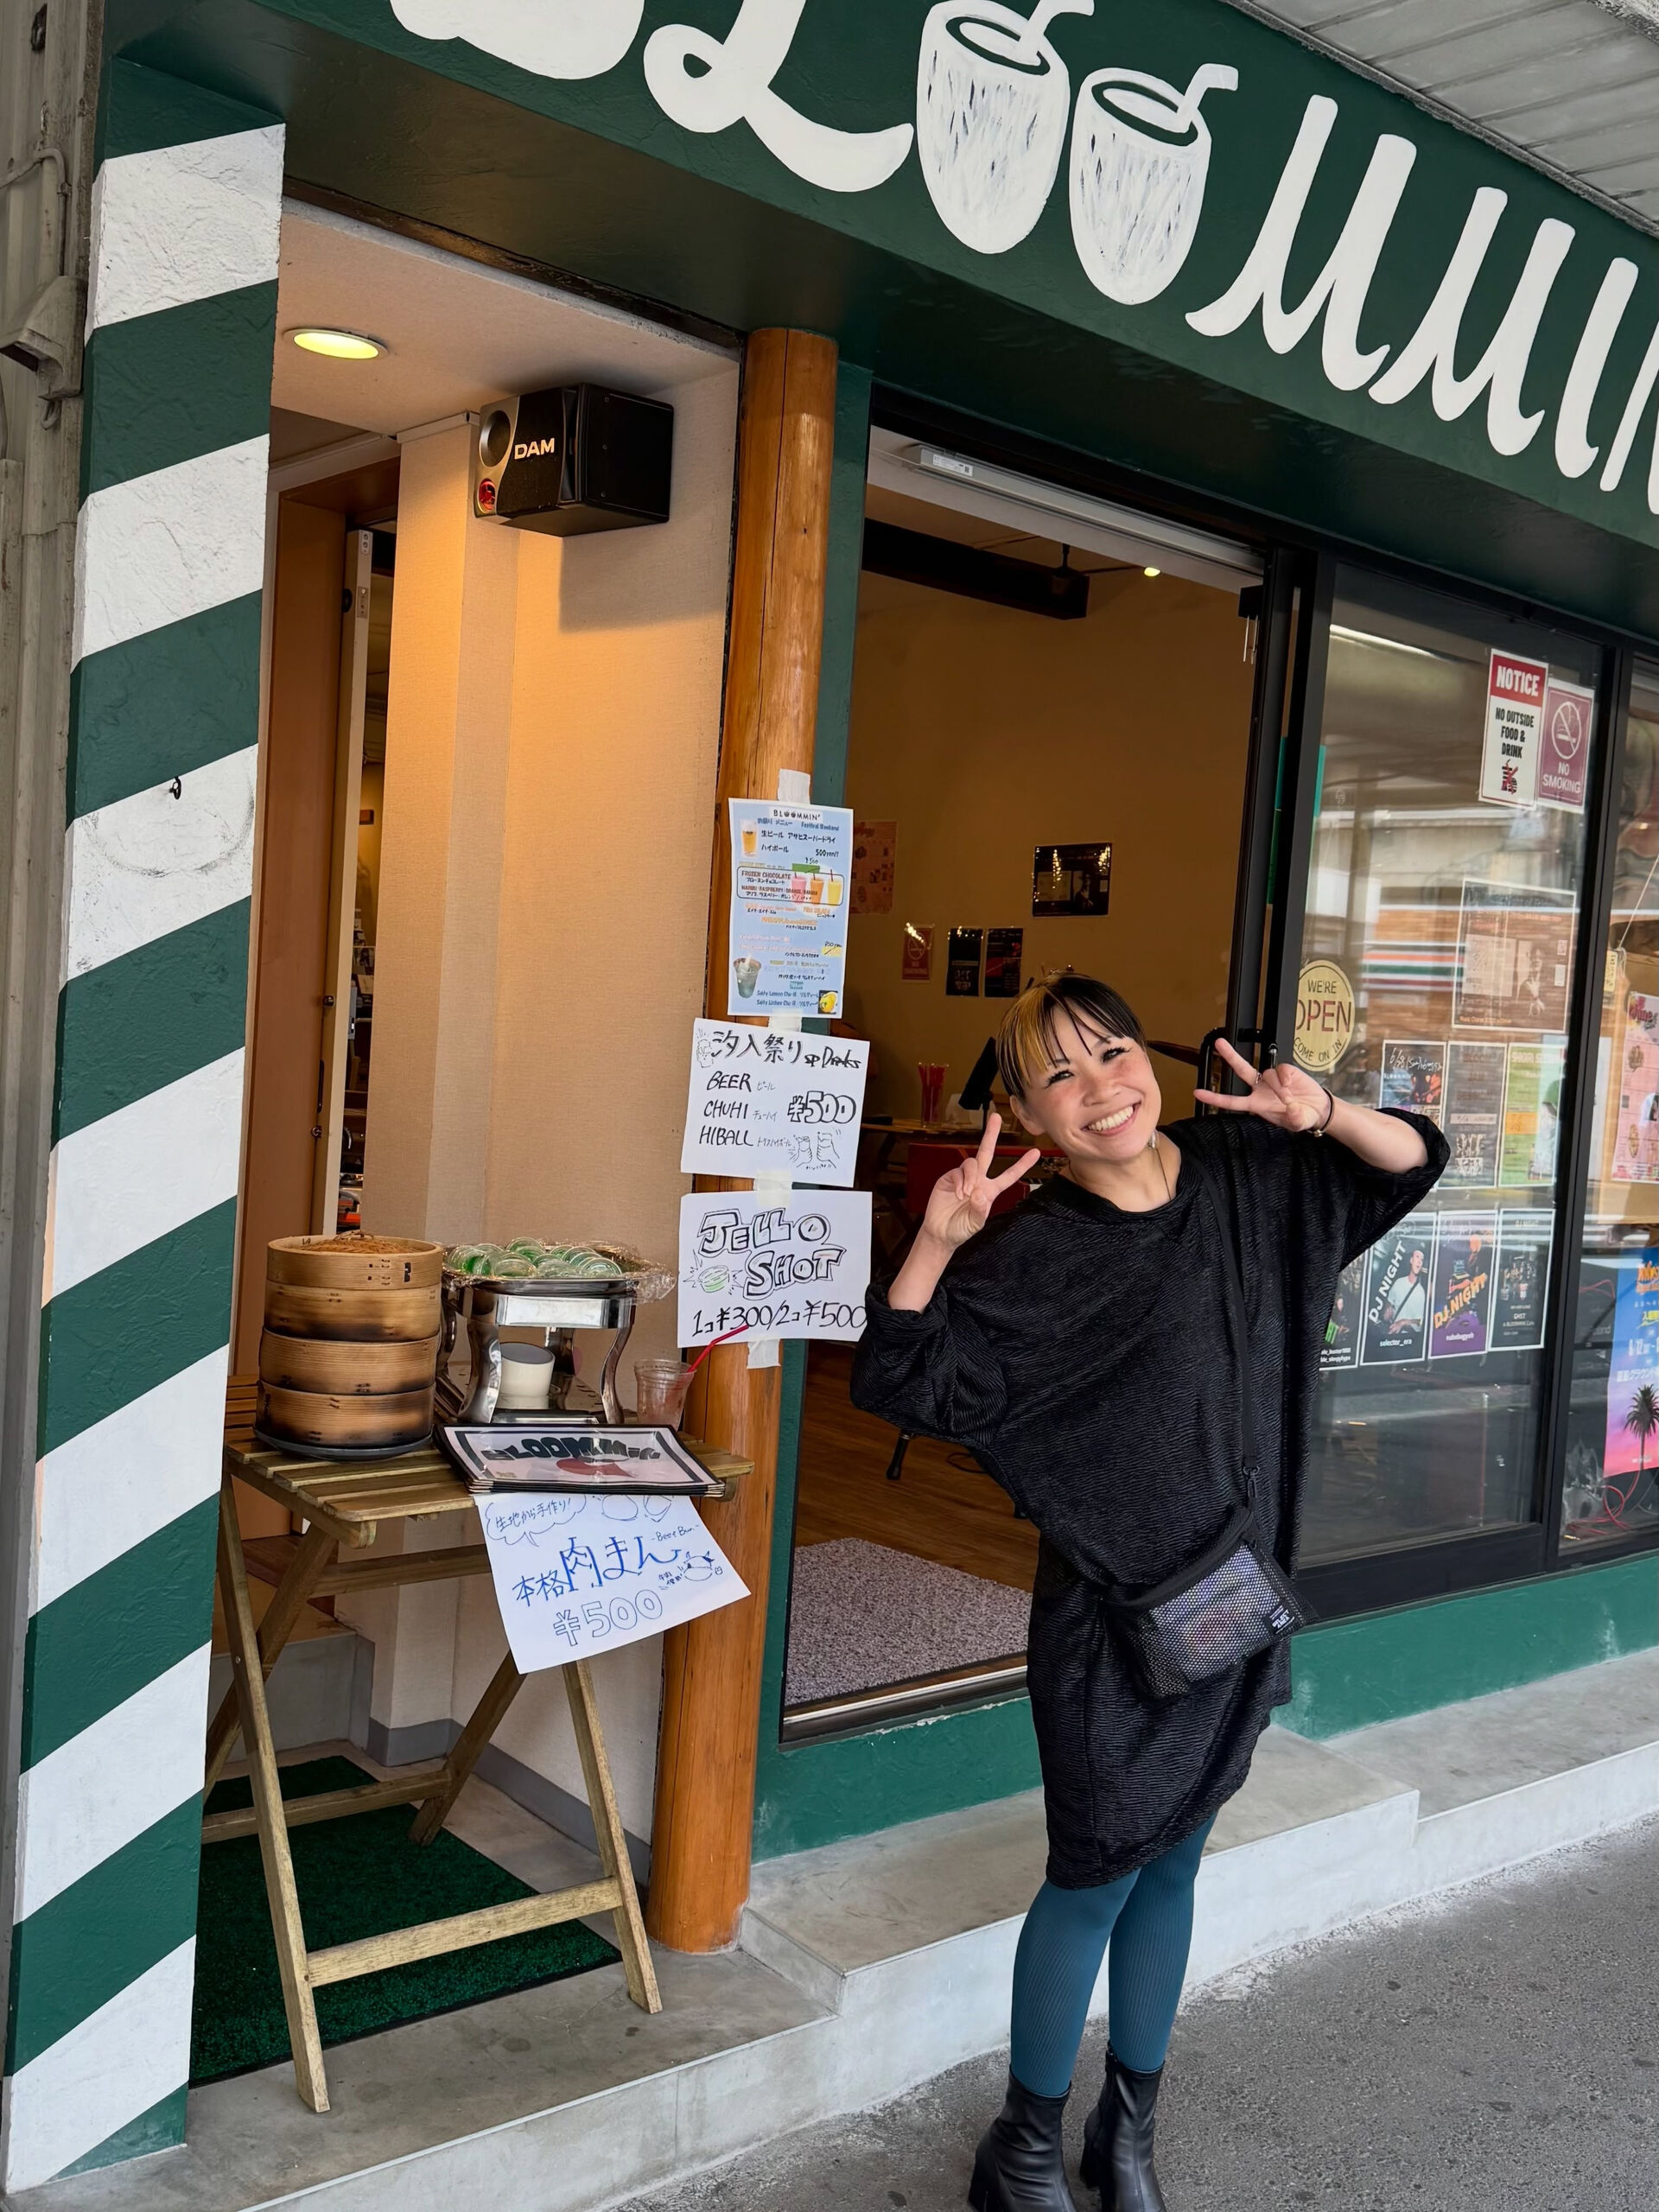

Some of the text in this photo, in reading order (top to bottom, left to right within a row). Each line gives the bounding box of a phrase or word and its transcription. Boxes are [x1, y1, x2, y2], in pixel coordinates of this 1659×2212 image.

[514, 437, 555, 460] DAM
[1496, 665, 1541, 696] NOTICE
[1495, 707, 1535, 728] NO OUTSIDE
[1500, 726, 1526, 742] FOOD &
[1501, 742, 1522, 759] DRINK
[1558, 762, 1570, 775] NO
[1542, 773, 1581, 793] SMOKING
[761, 843, 790, 854] ハイボール
[762, 871, 791, 880] CHOCOLATE
[1307, 979, 1338, 994] WE'RE
[710, 1029, 802, 1065] 汐入祭り
[1294, 1037, 1343, 1062] COME ON IN
[706, 1071, 752, 1093] BEER
[756, 1080, 776, 1091] ビール
[703, 1099, 749, 1120] CHUHI
[787, 1090, 857, 1124] ¥500
[699, 1125, 754, 1147] HIBALL
[698, 1208, 830, 1256] JELLO
[744, 1247, 847, 1300] SHOT
[1368, 1240, 1408, 1325] DJ NIGHT
[1449, 1272, 1488, 1314] NIGHT
[553, 1589, 664, 1647] ¥500
